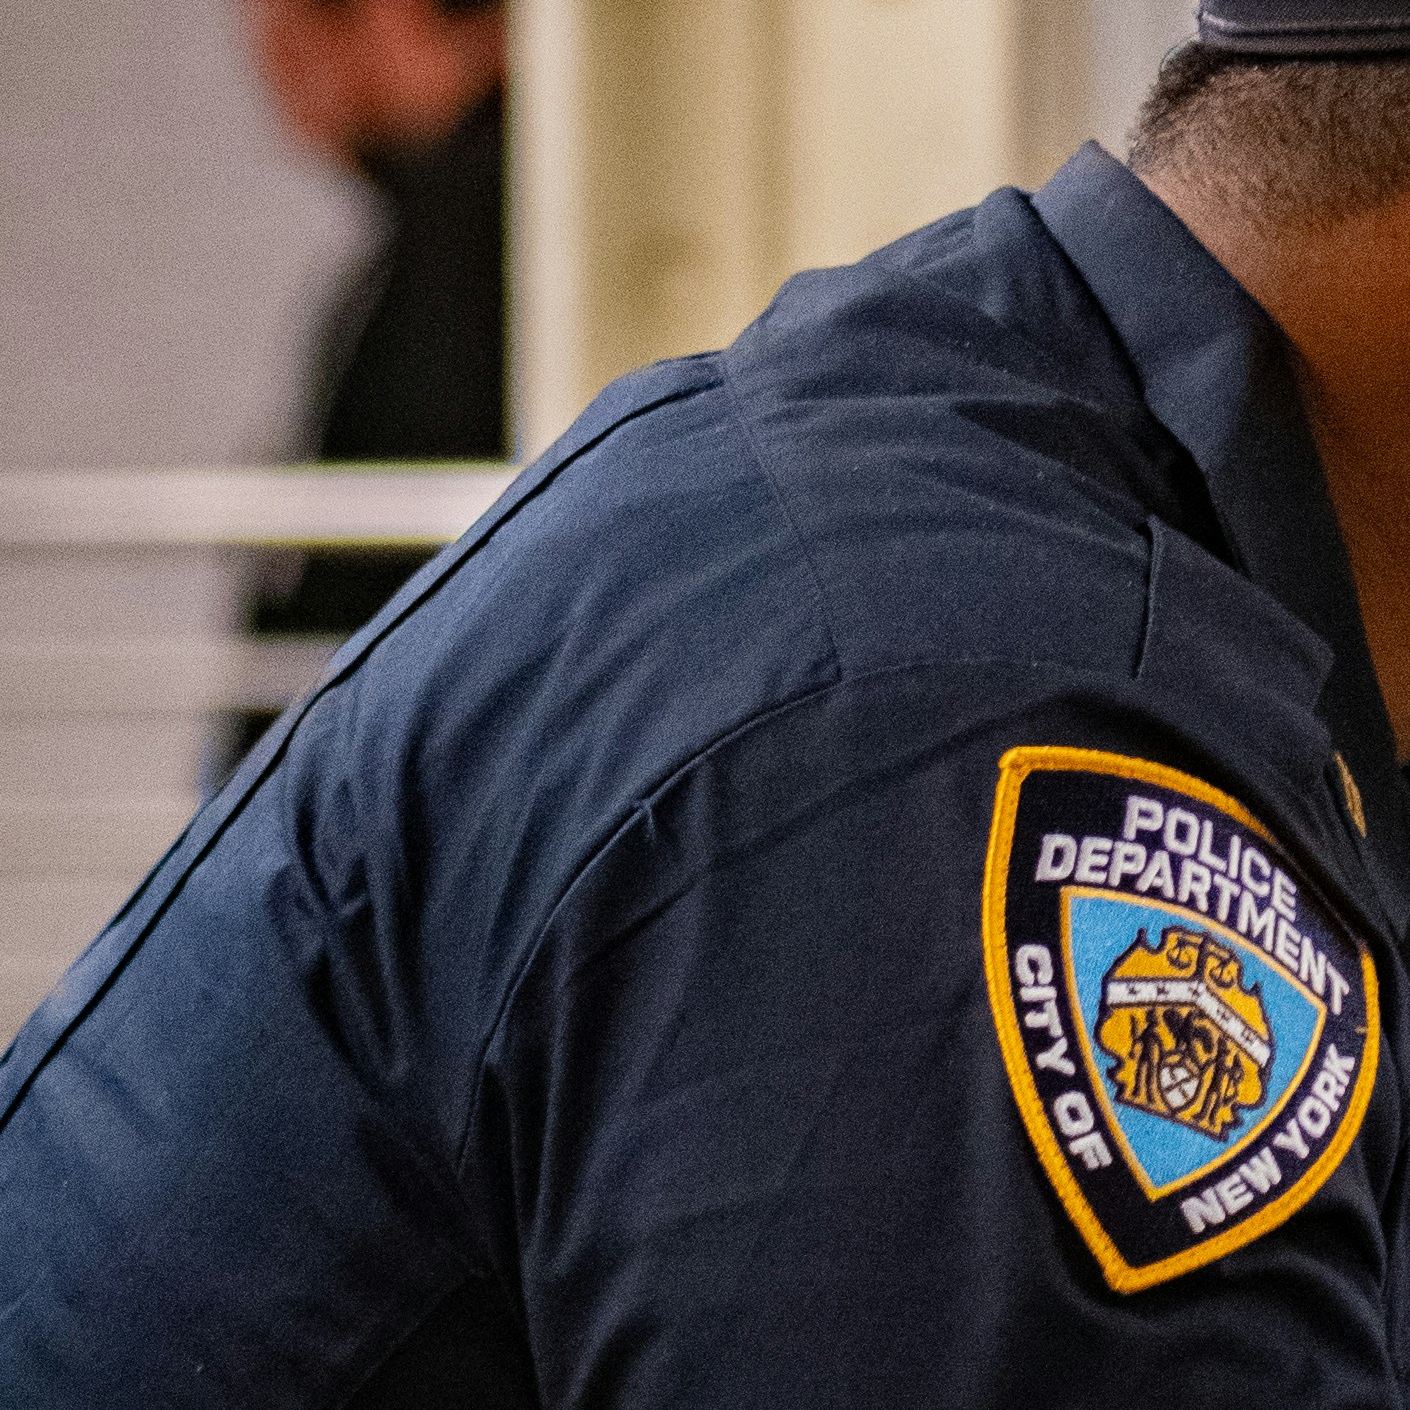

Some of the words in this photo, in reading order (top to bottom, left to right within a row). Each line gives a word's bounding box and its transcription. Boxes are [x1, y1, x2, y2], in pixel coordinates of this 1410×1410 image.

[1035, 834, 1350, 1015] DEPARTMENT
[1124, 795, 1297, 918] POLICE
[1015, 944, 1075, 1080] CITY
[1054, 1092, 1113, 1170] OF
[1180, 1150, 1283, 1234] NEW
[1279, 1043, 1356, 1158] YORK
